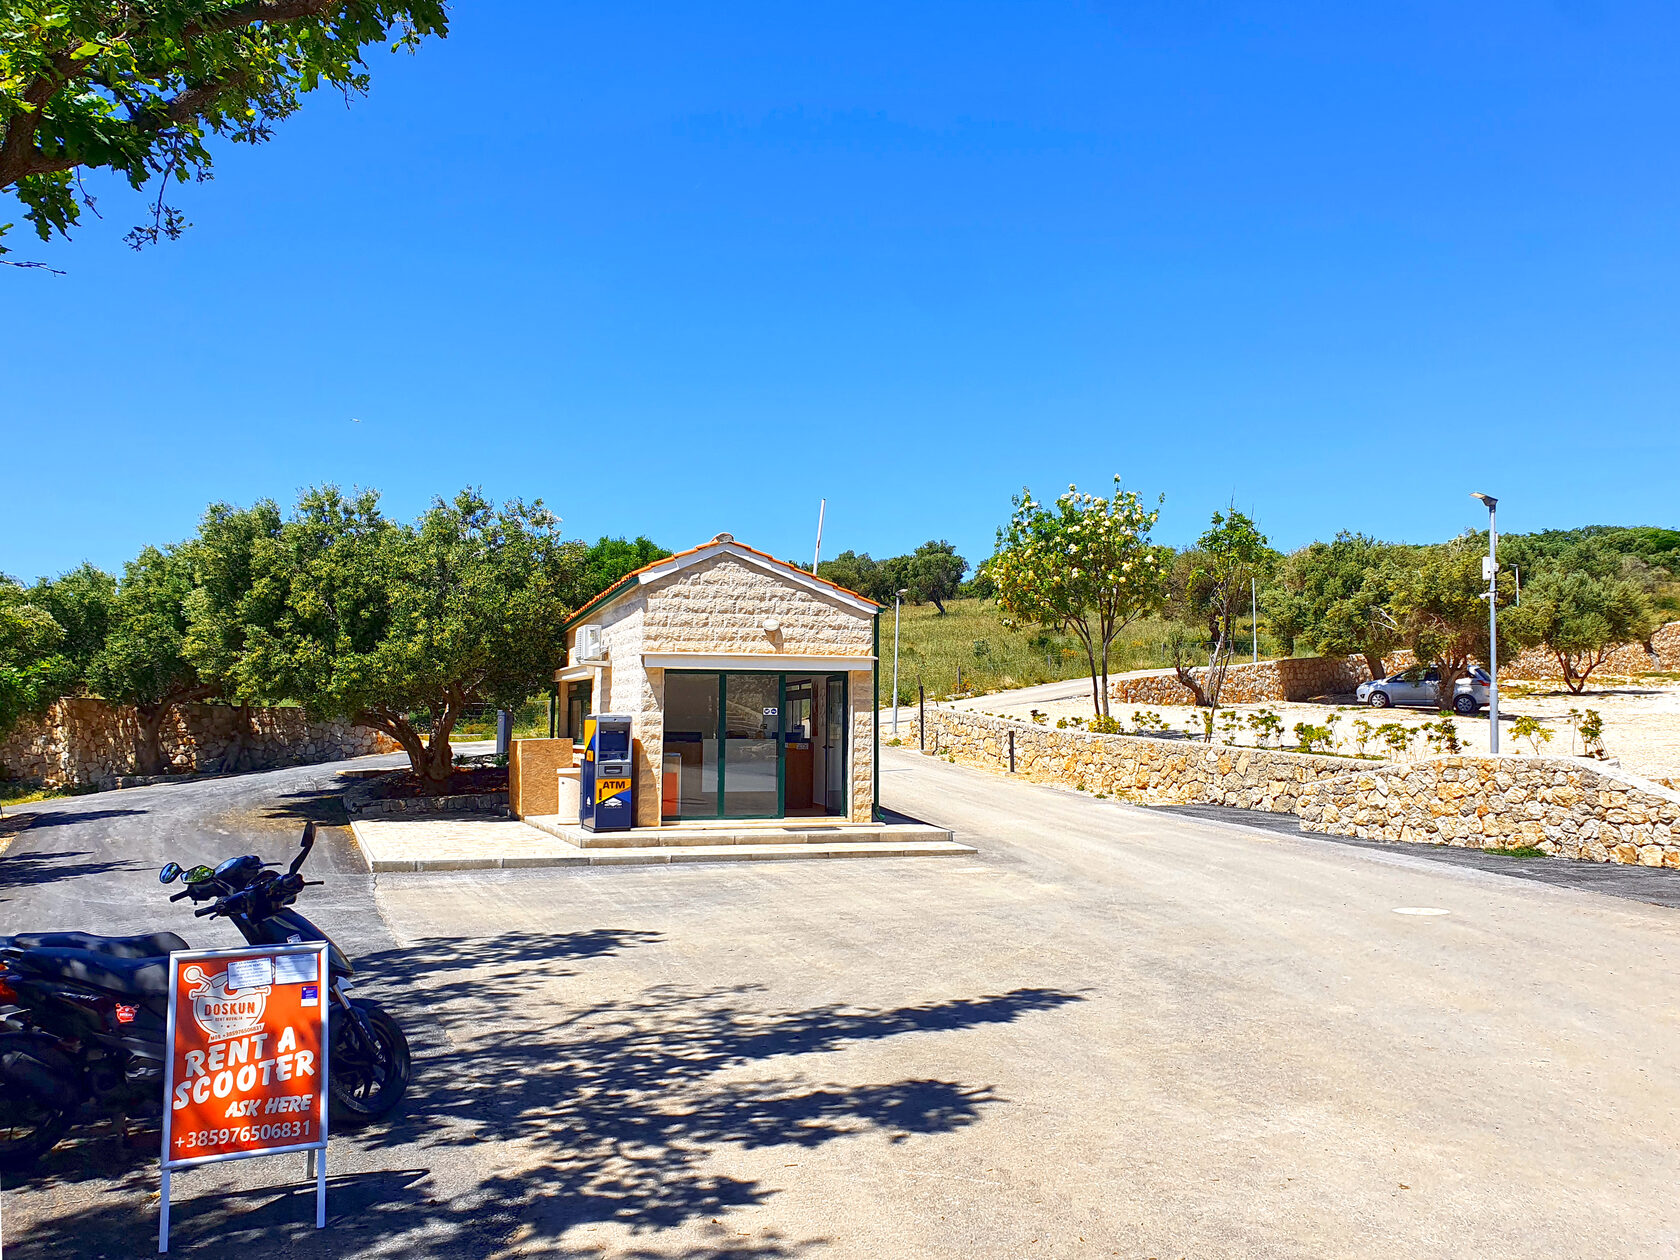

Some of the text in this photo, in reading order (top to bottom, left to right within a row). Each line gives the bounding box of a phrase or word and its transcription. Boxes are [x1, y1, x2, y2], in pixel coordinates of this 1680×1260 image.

[602, 781, 626, 790] ATM
[204, 1002, 255, 1016] DOSKUN
[185, 1027, 296, 1077] RENT A
[173, 1050, 315, 1110] SCOOTER
[225, 1094, 313, 1118] ASK HERE
[175, 1120, 310, 1148] +385976506831
